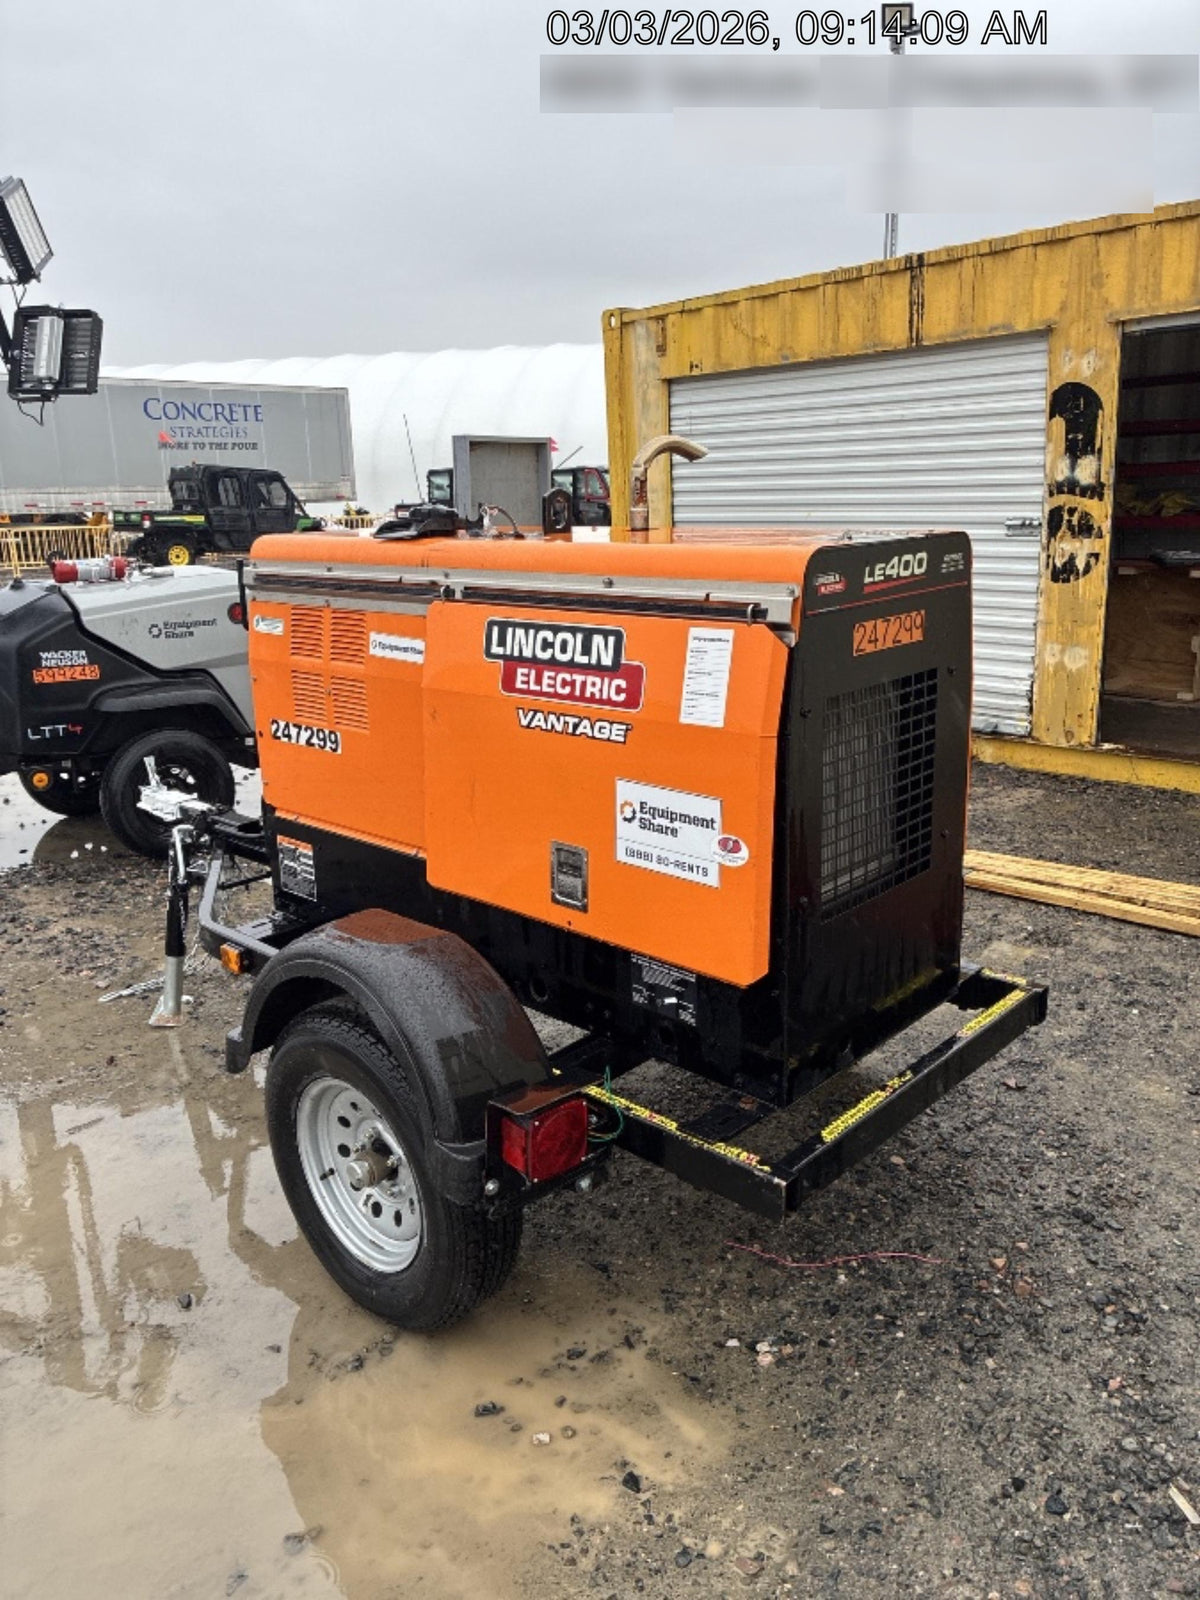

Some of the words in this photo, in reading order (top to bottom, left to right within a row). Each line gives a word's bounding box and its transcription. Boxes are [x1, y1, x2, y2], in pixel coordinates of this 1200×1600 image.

[169, 426, 248, 439] STRATEGIES
[191, 442, 206, 450] TO
[208, 442, 229, 450] THE
[230, 442, 258, 450] POUR
[863, 551, 928, 584] LE400
[490, 625, 615, 667] LINCOLN
[855, 611, 924, 653] 247299
[39, 650, 86, 659] WACKER
[42, 658, 88, 667] NEUSON
[515, 667, 627, 702] ELECTRIC
[271, 719, 340, 752] 247299
[517, 708, 628, 744] VANTAGE
[638, 817, 679, 838] Share
[639, 801, 717, 831] Equipment
